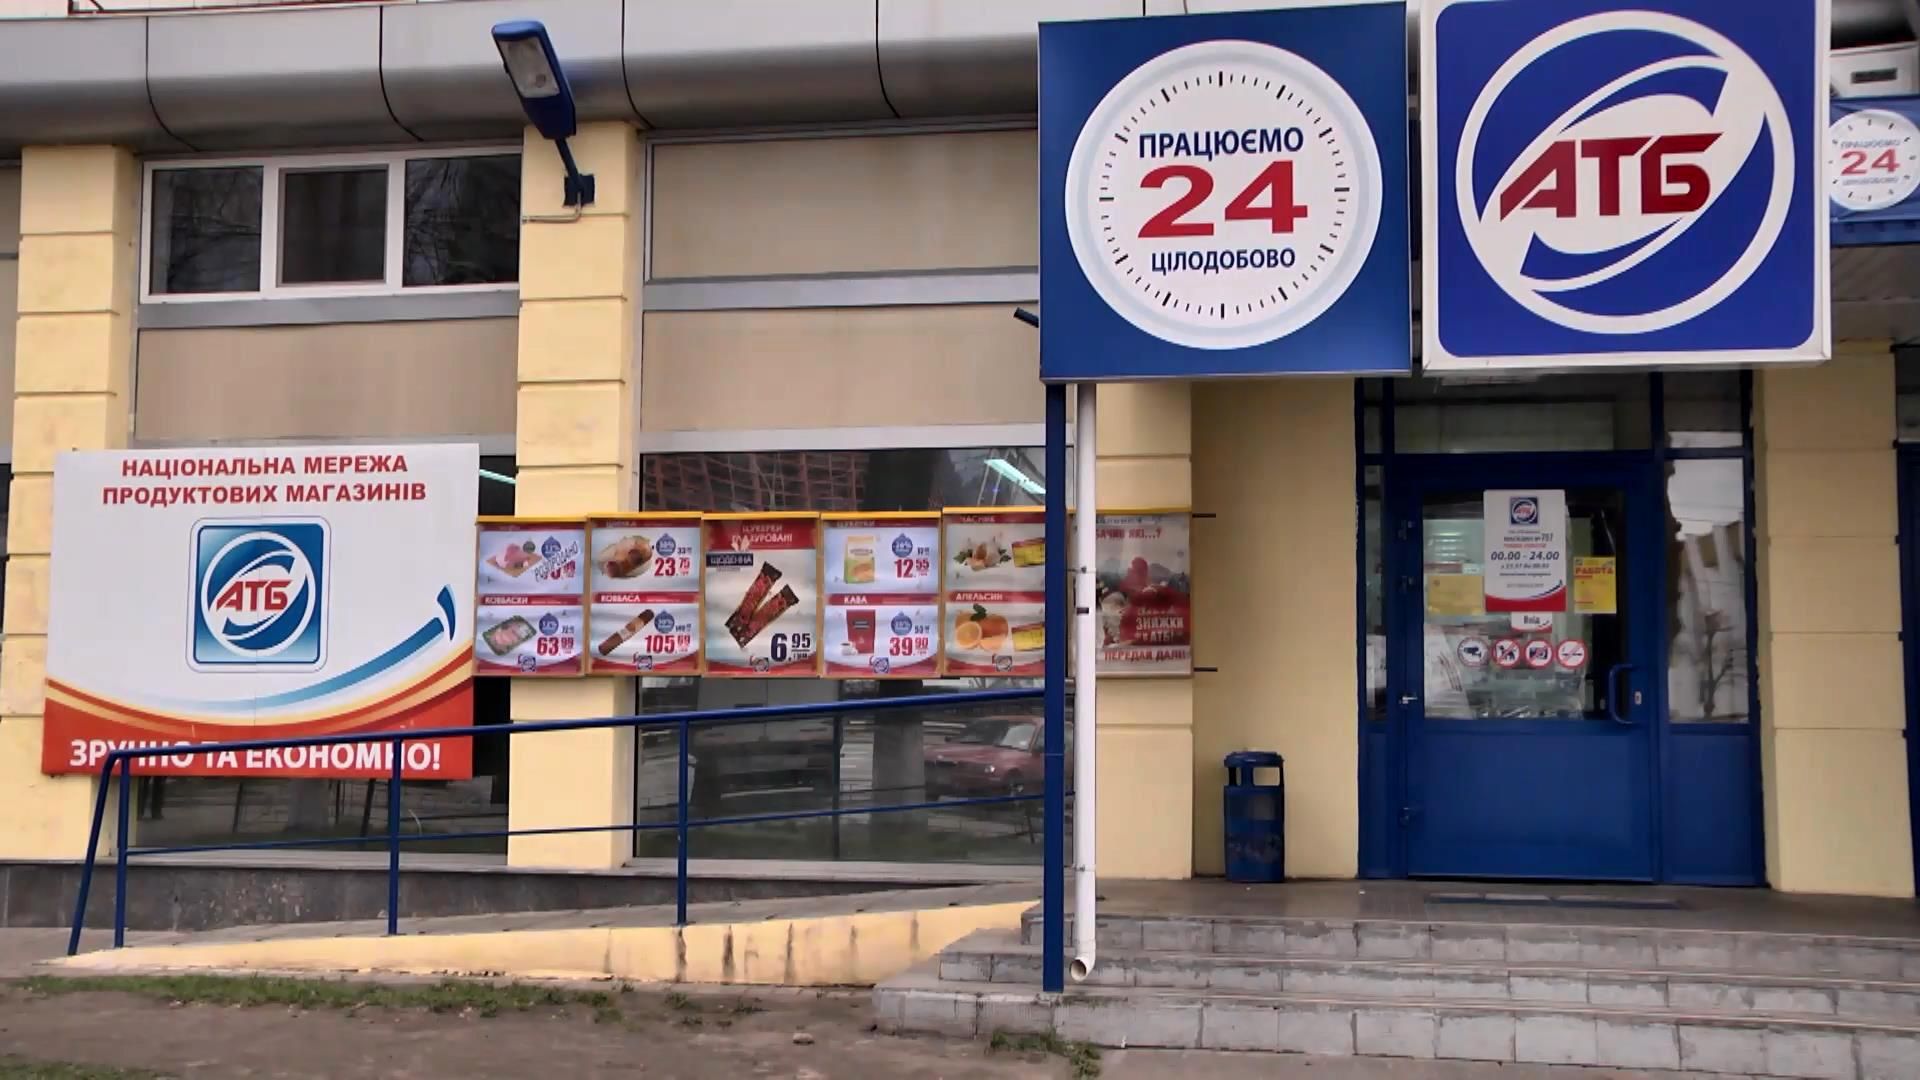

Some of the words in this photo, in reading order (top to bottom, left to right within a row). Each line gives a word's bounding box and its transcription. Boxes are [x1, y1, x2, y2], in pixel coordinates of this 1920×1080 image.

[1139, 127, 1304, 162] ПРАЦЮЄМО
[1500, 132, 1724, 222] АТБ
[1841, 149, 1900, 176] 24
[1137, 160, 1308, 239] 24
[1151, 247, 1296, 276] ЦІЛОДОБОВО
[121, 457, 296, 480] НАЦІОНАЛЬНА
[303, 455, 408, 474] МЕРЕЖА
[103, 485, 278, 508] ПРОДУКТОВИХ
[286, 483, 427, 503] МАГАЗИНІВ
[1491, 551, 1521, 561] 00.00
[1529, 551, 1560, 561] 24.00
[216, 581, 292, 612] АТБ
[843, 595, 868, 604] КАВА
[245, 742, 441, 771] ЕКОНОМНО!
